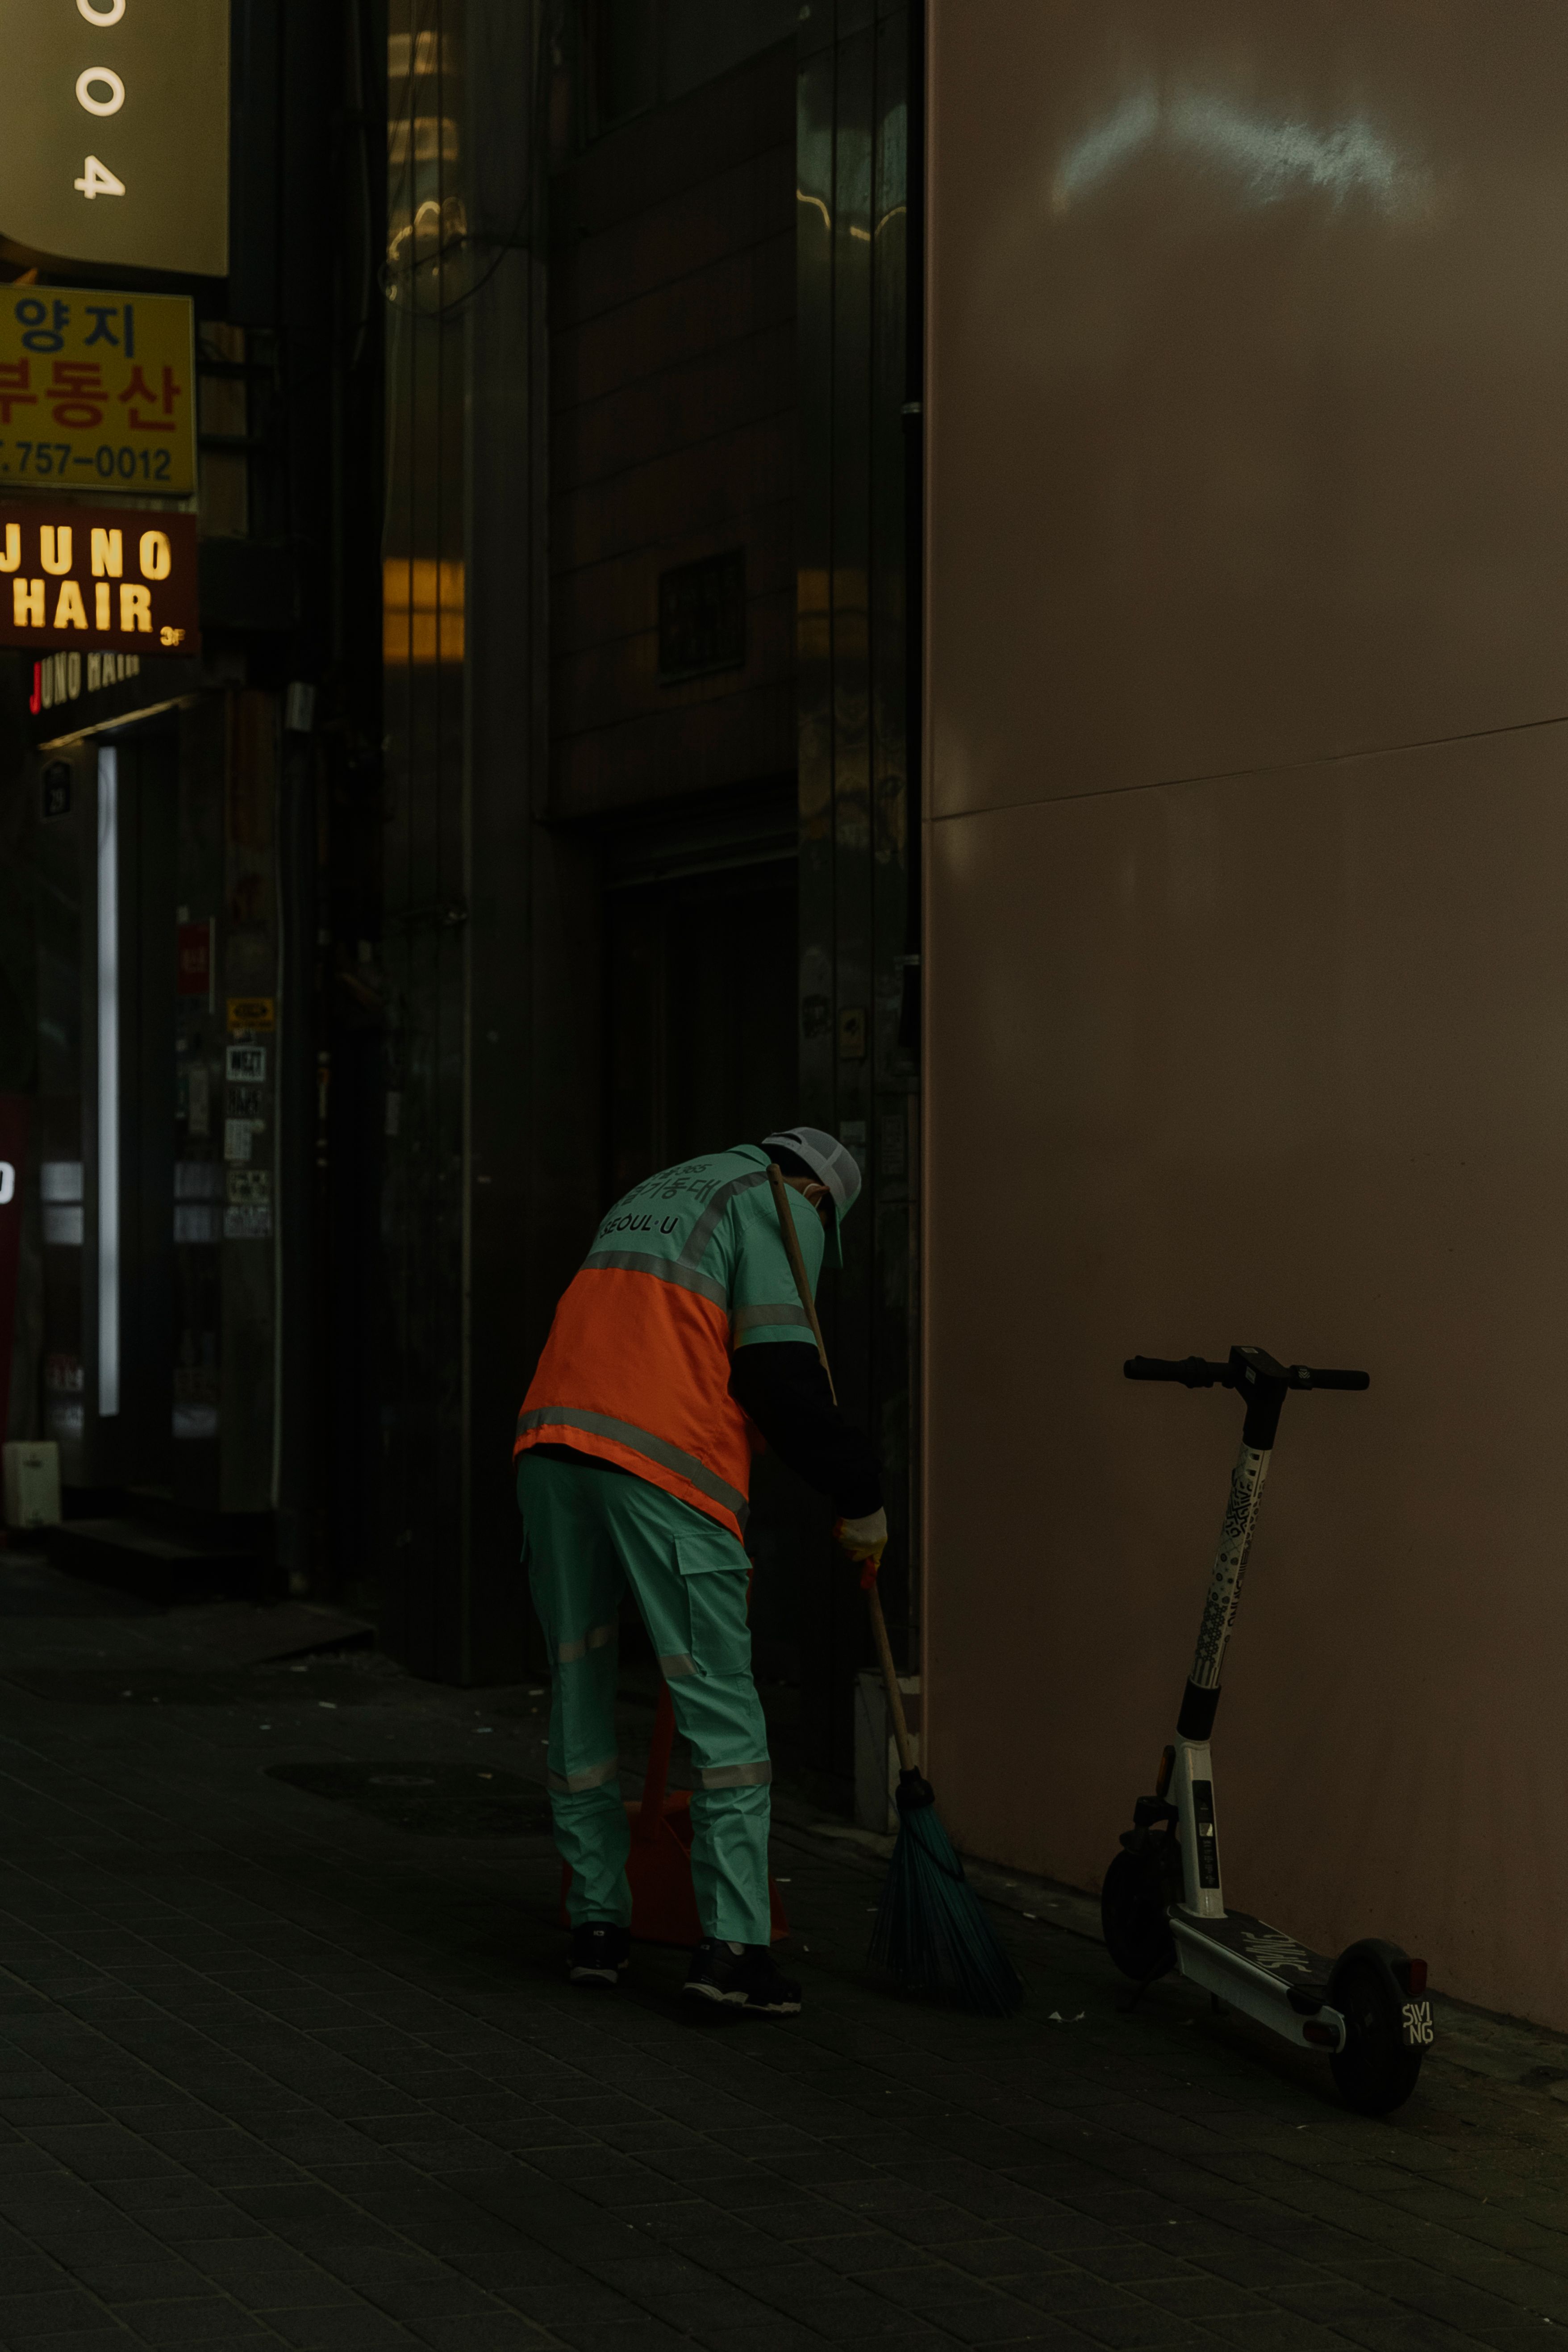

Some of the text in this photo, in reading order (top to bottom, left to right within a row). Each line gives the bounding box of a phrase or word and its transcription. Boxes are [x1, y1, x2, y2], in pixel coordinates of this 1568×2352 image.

[15, 298, 133, 358] 양지
[0, 523, 171, 580] JUNO
[13, 577, 153, 633] HAIR
[160, 626, 186, 647] 3F
